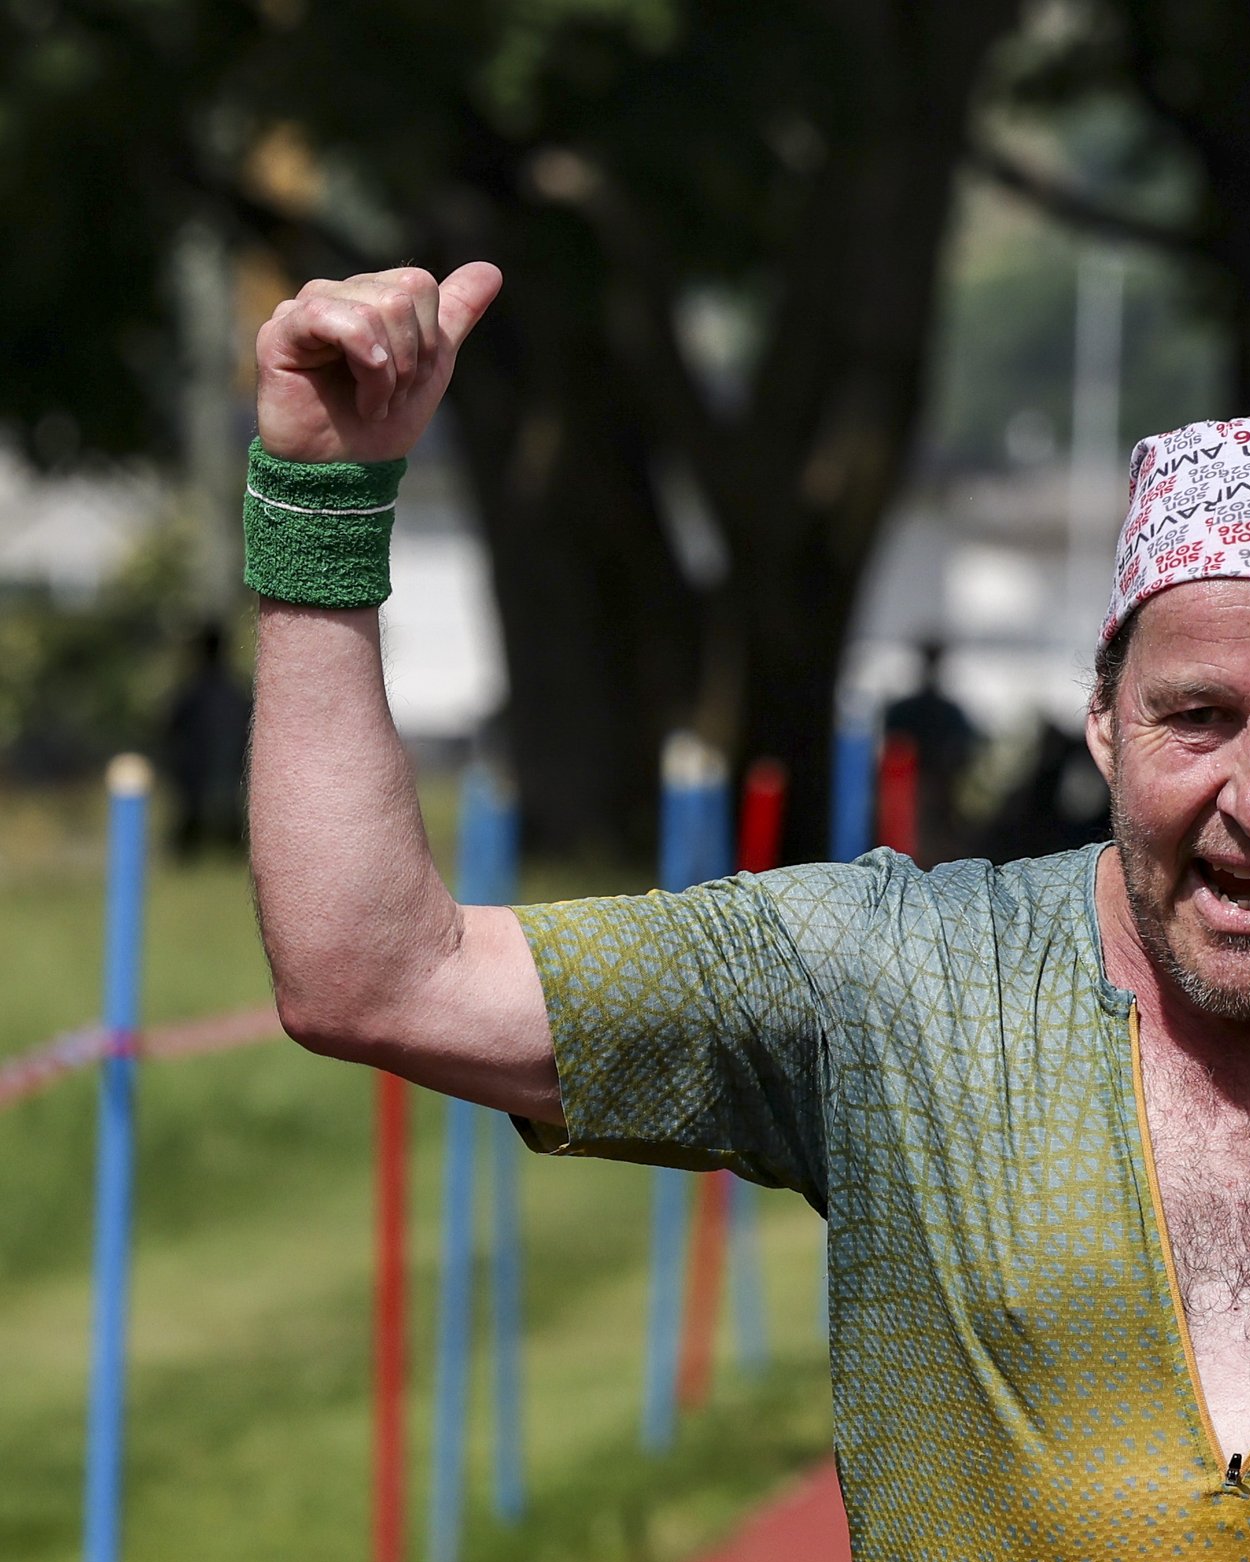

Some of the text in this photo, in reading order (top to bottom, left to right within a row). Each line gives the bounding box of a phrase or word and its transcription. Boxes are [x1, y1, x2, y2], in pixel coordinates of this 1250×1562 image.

[1166, 434, 1202, 454] sion
[1162, 482, 1210, 505] 2026
[1165, 491, 1206, 512] sion
[1147, 524, 1189, 553] 2026
[1149, 535, 1186, 559] sion
[1155, 541, 1203, 566] 2026
[1158, 553, 1199, 574] sion
